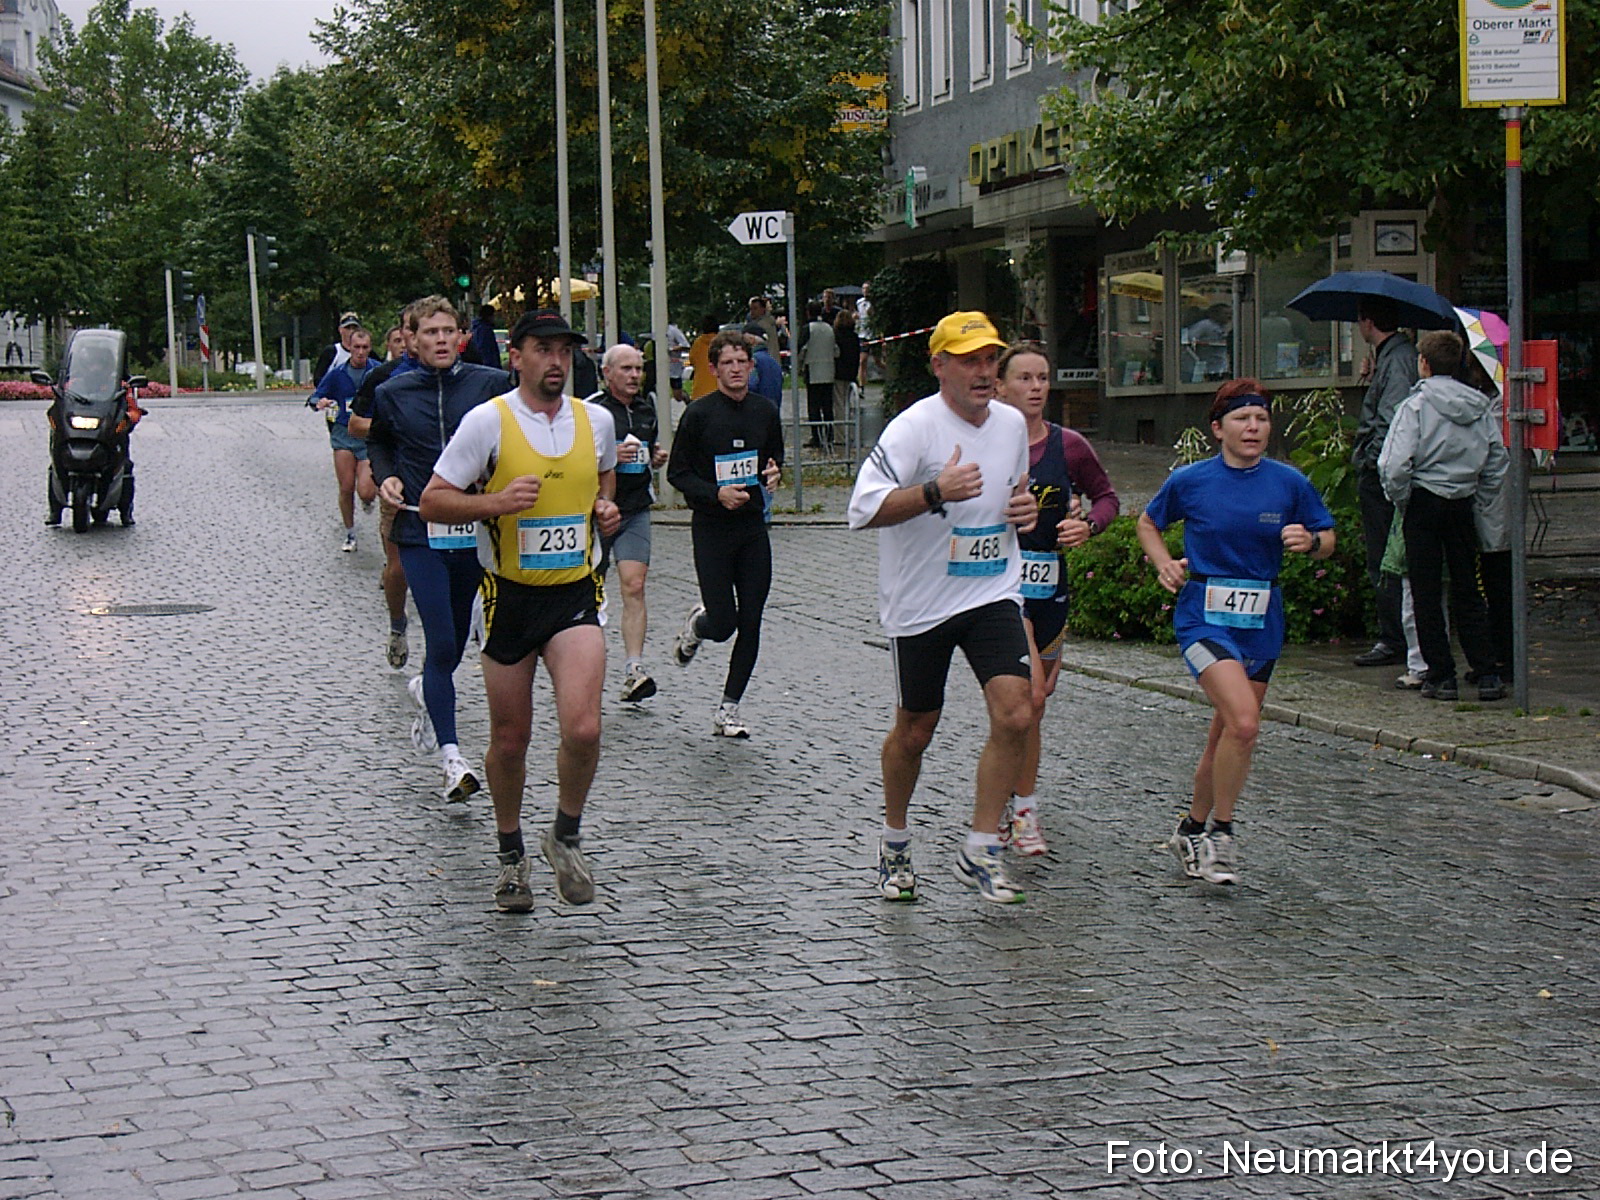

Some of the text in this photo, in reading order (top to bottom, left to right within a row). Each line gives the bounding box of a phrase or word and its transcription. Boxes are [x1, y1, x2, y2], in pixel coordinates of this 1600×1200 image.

[1472, 18, 1551, 30] Oberer Markt
[745, 215, 779, 240] WC
[730, 459, 753, 478] 415
[539, 526, 577, 552] 233
[969, 537, 1000, 560] 468
[1021, 562, 1051, 583] 462
[1224, 591, 1260, 613] 477
